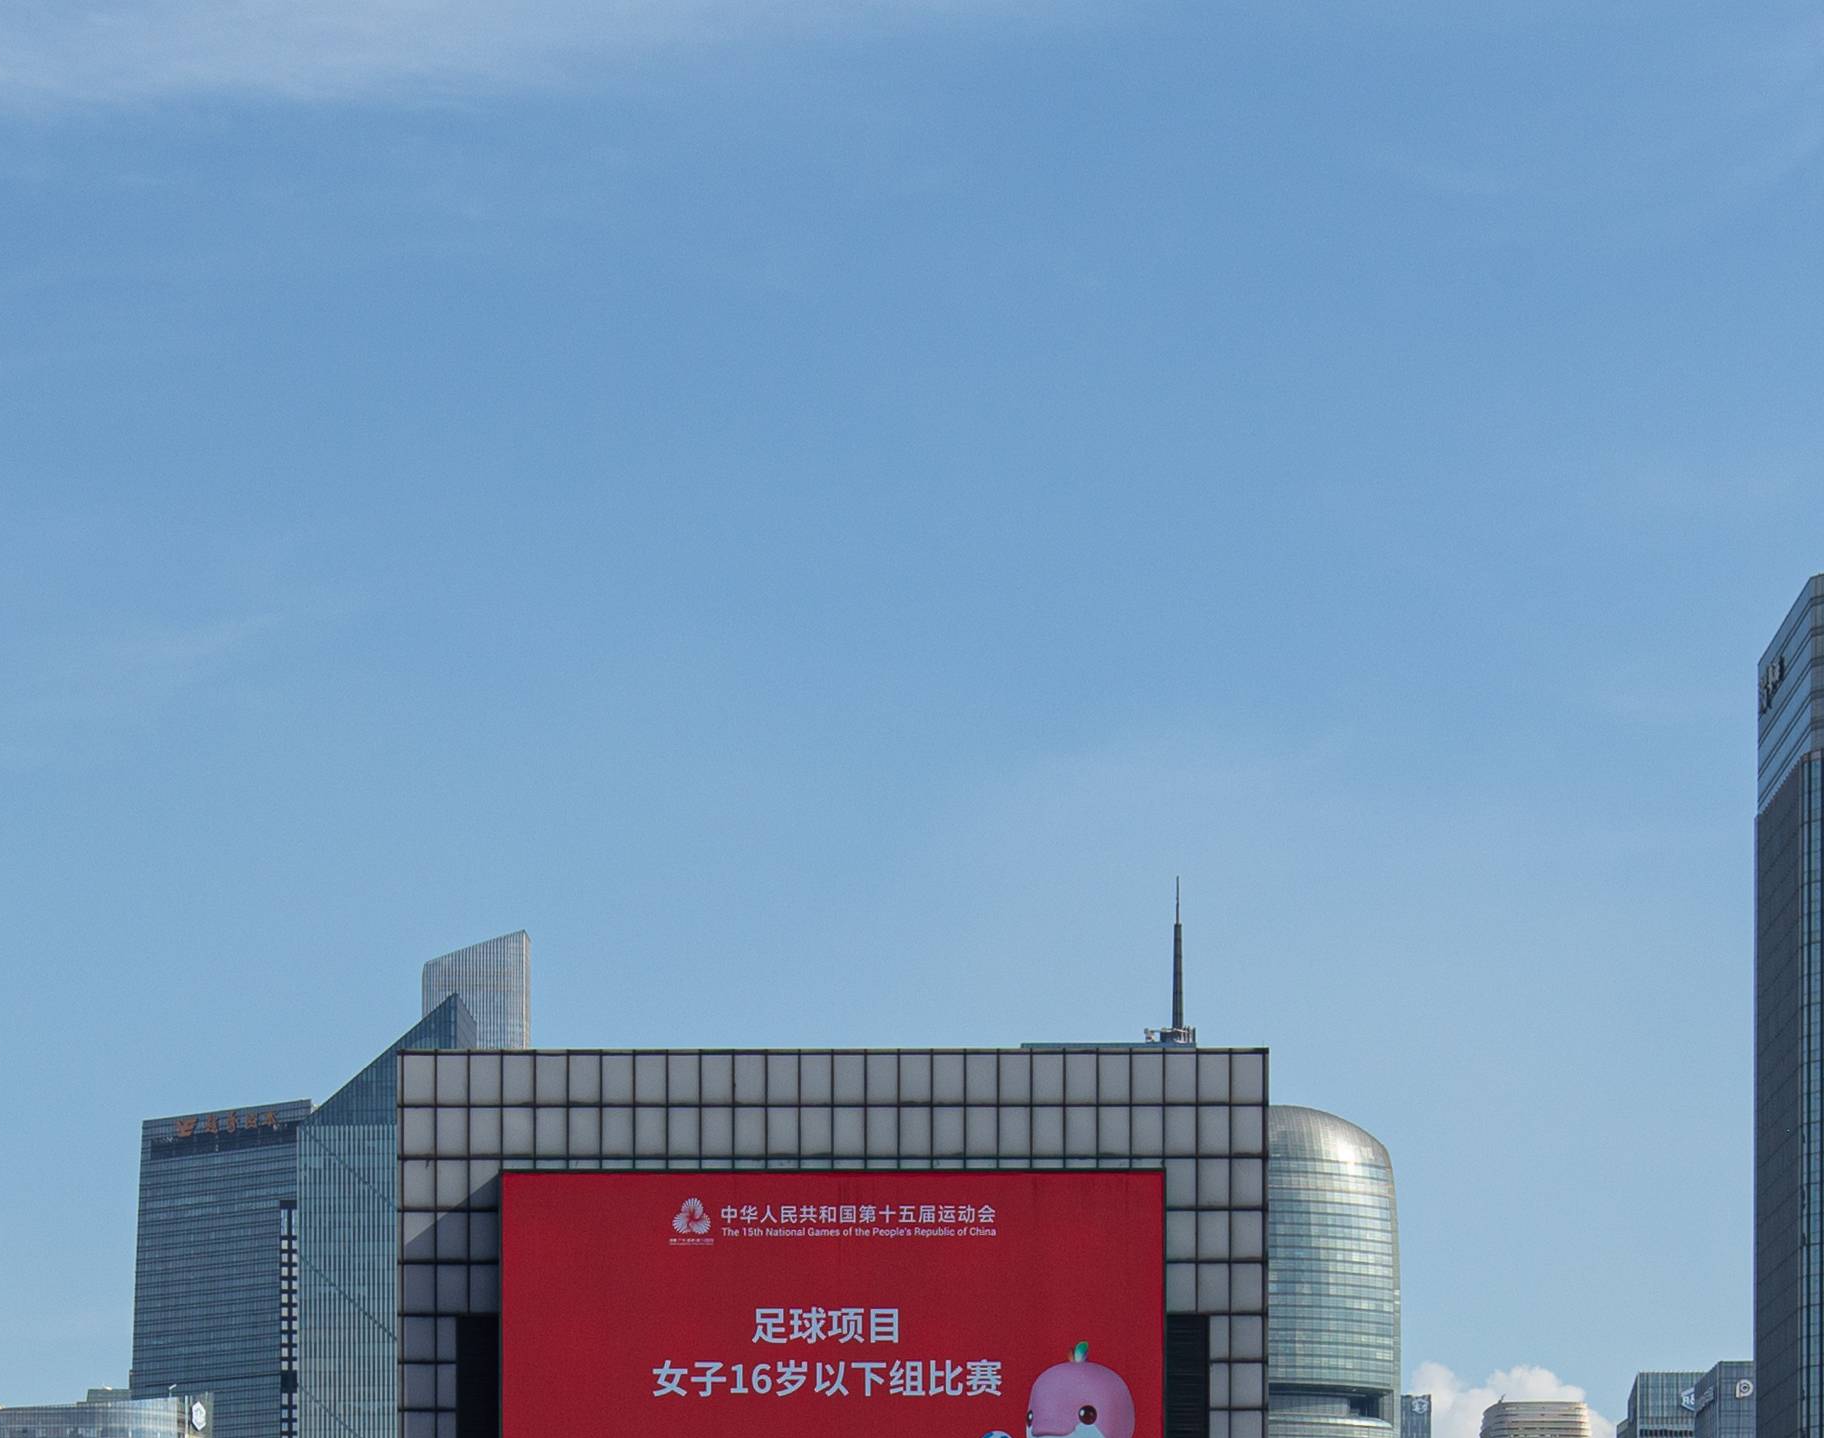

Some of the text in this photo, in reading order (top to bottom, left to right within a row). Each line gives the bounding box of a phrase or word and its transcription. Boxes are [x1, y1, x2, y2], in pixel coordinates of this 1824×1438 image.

[721, 1205, 996, 1224] 中华人民共和国第十五届运动会
[722, 1227, 996, 1239] The 15th National Games of the People's Republic of China
[752, 1308, 900, 1343] 足球项目
[652, 1361, 1003, 1398] 女子16岁以下组比赛
